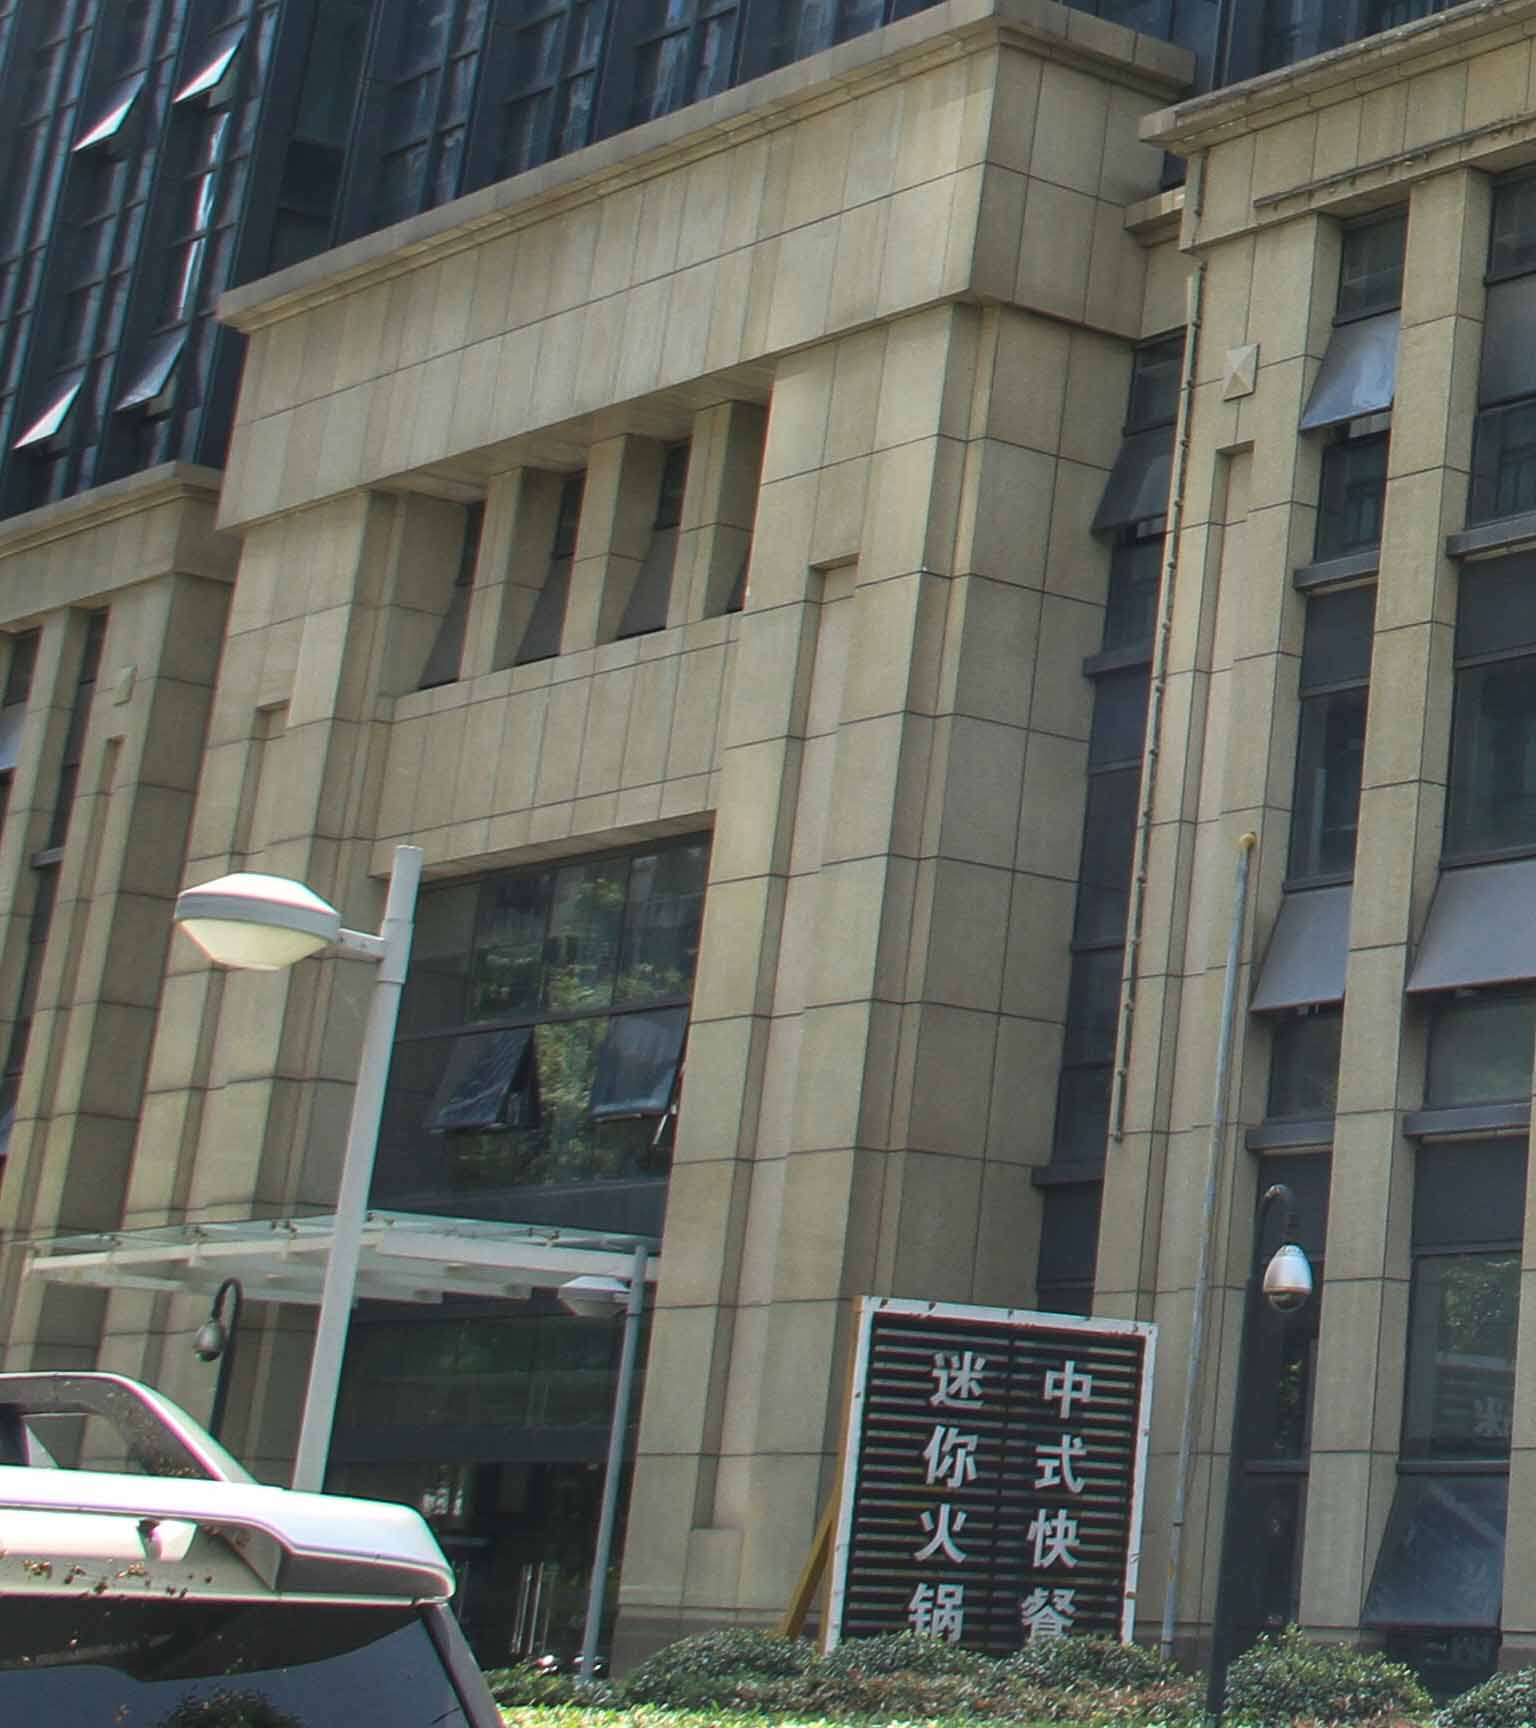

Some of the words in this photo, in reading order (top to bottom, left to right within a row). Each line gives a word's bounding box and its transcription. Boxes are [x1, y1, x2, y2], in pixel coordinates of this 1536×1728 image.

[908, 1350, 988, 1643] 迷你火锅
[1020, 1360, 1093, 1642] 中式快餐
